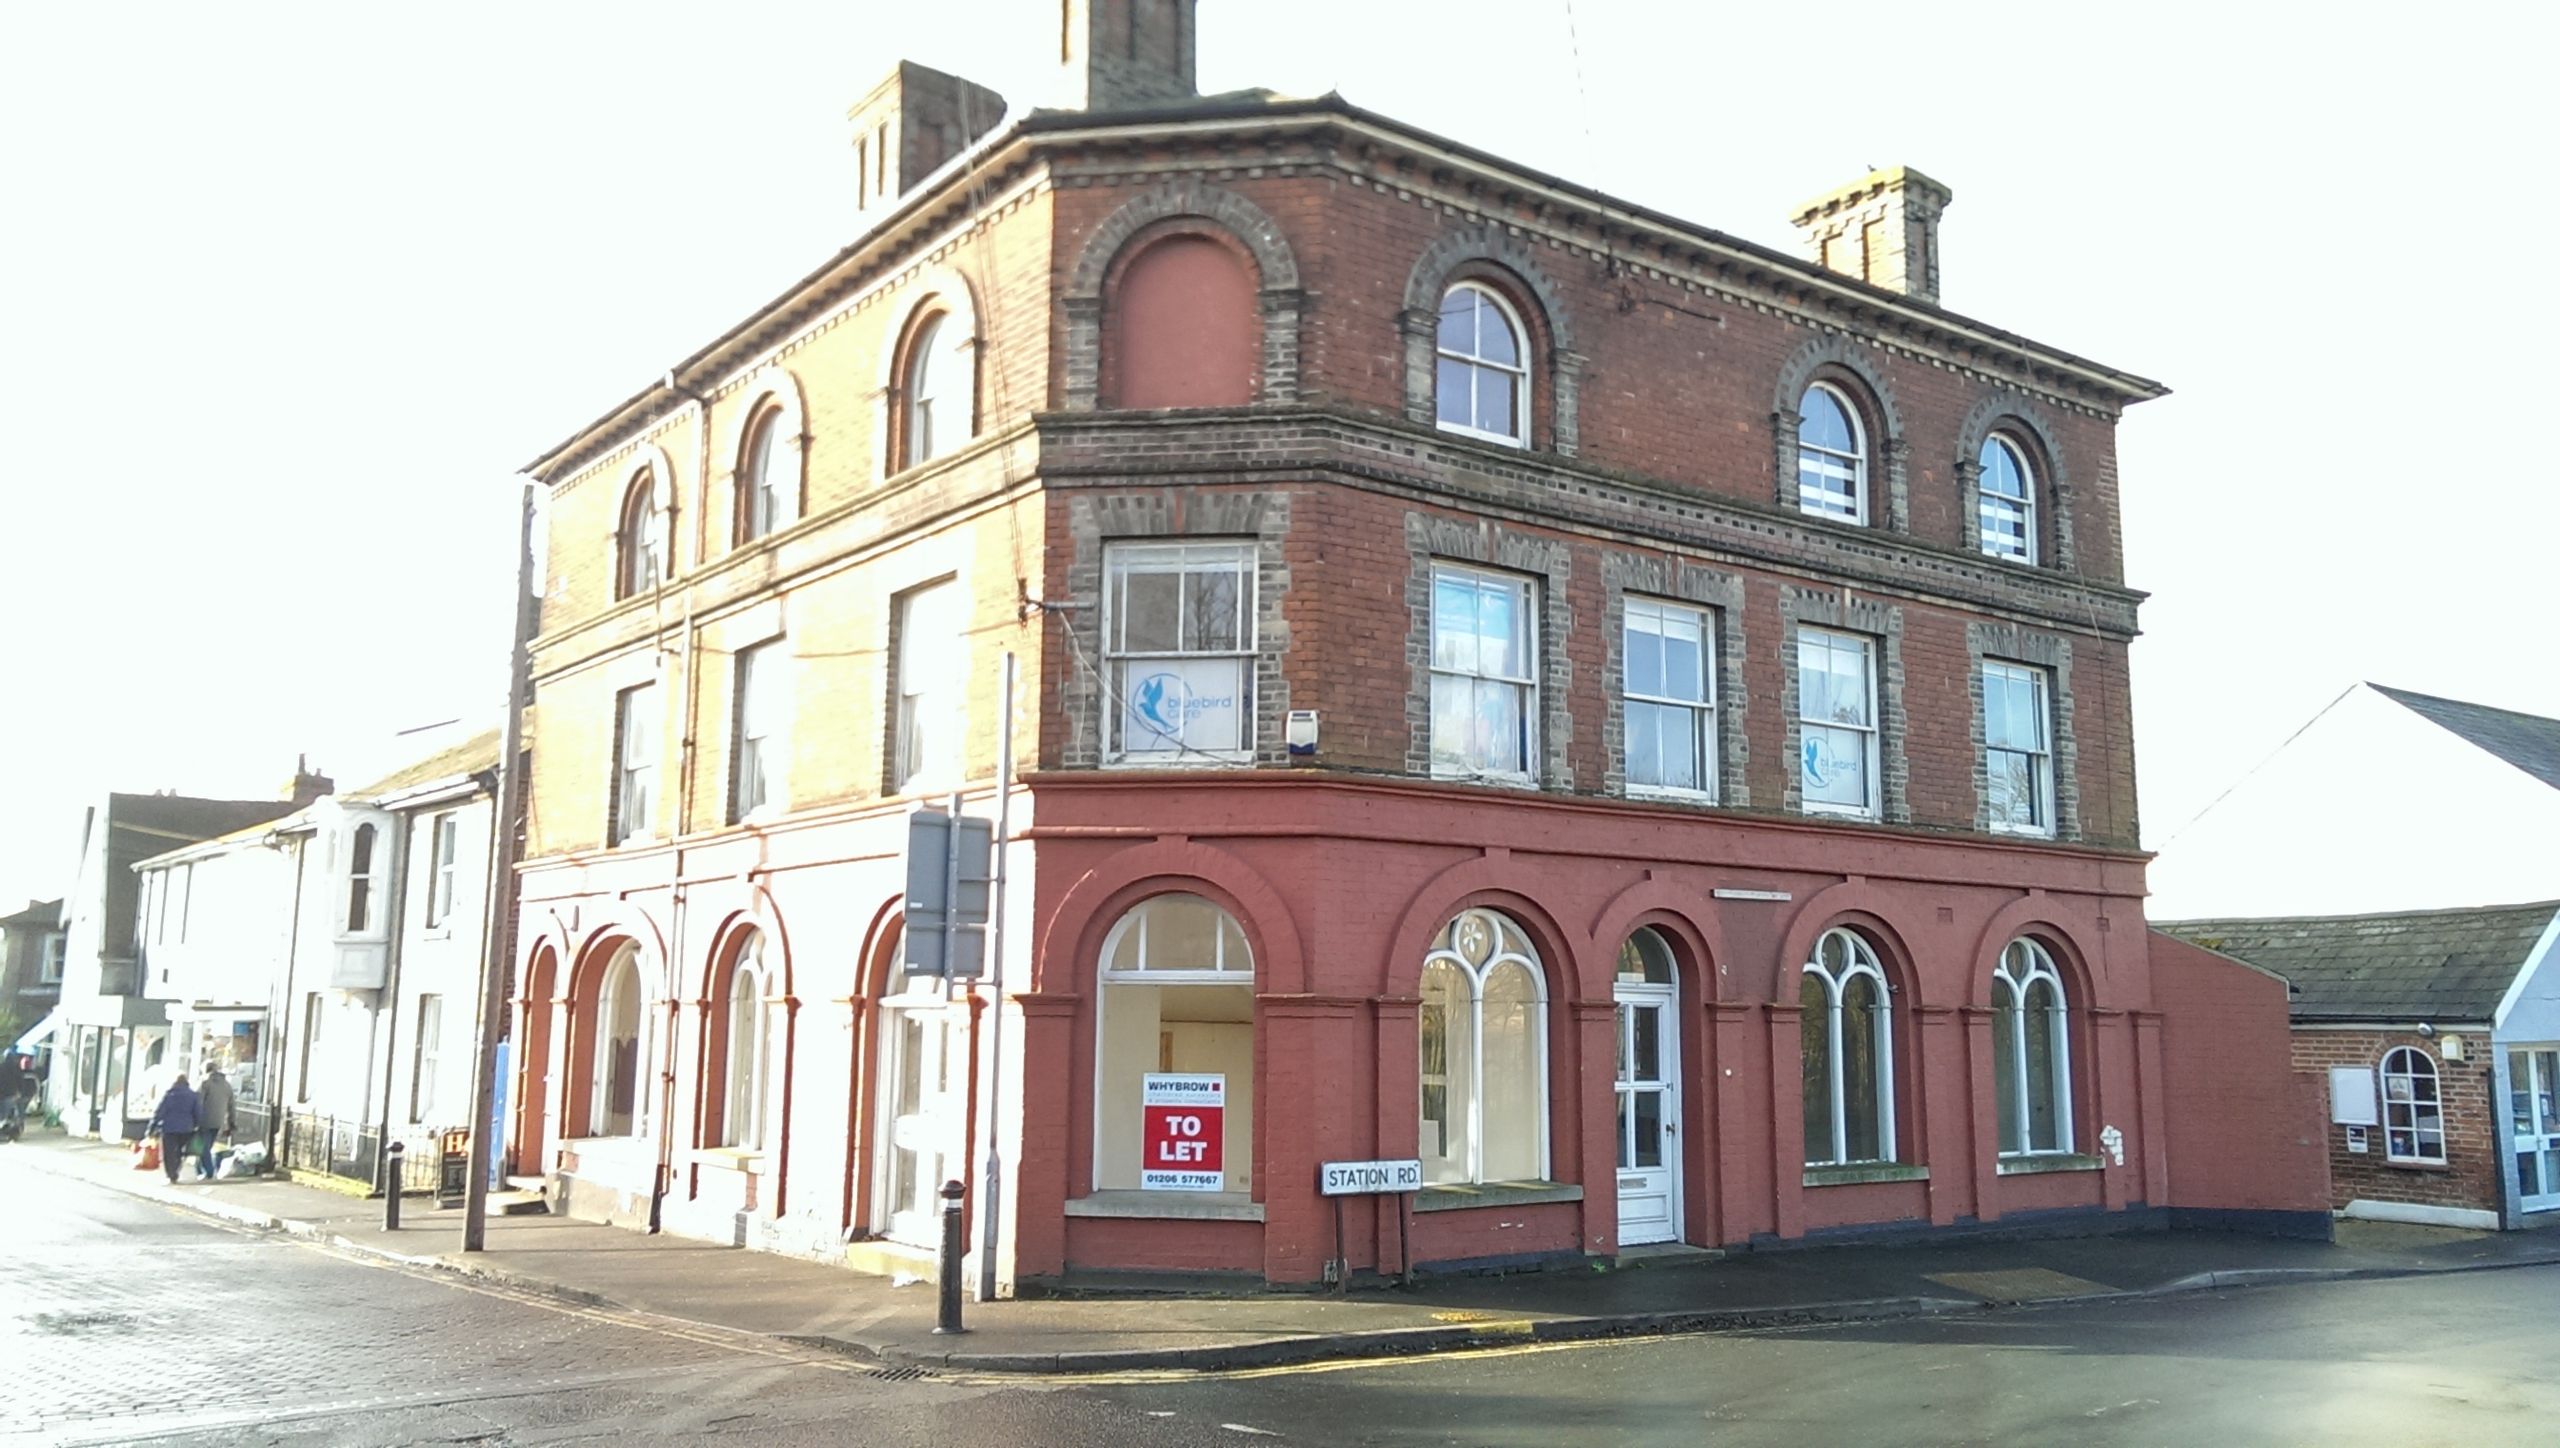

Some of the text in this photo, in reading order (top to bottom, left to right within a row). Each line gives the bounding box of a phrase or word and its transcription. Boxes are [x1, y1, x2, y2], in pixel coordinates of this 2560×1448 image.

[1167, 695, 1232, 708] bluebird
[1148, 1081, 1209, 1092] WHYBROW
[1165, 1115, 1202, 1137] TO
[1160, 1140, 1208, 1162] LET
[1147, 1174, 1218, 1185] 01206 577667
[1329, 1168, 1389, 1187] STATION
